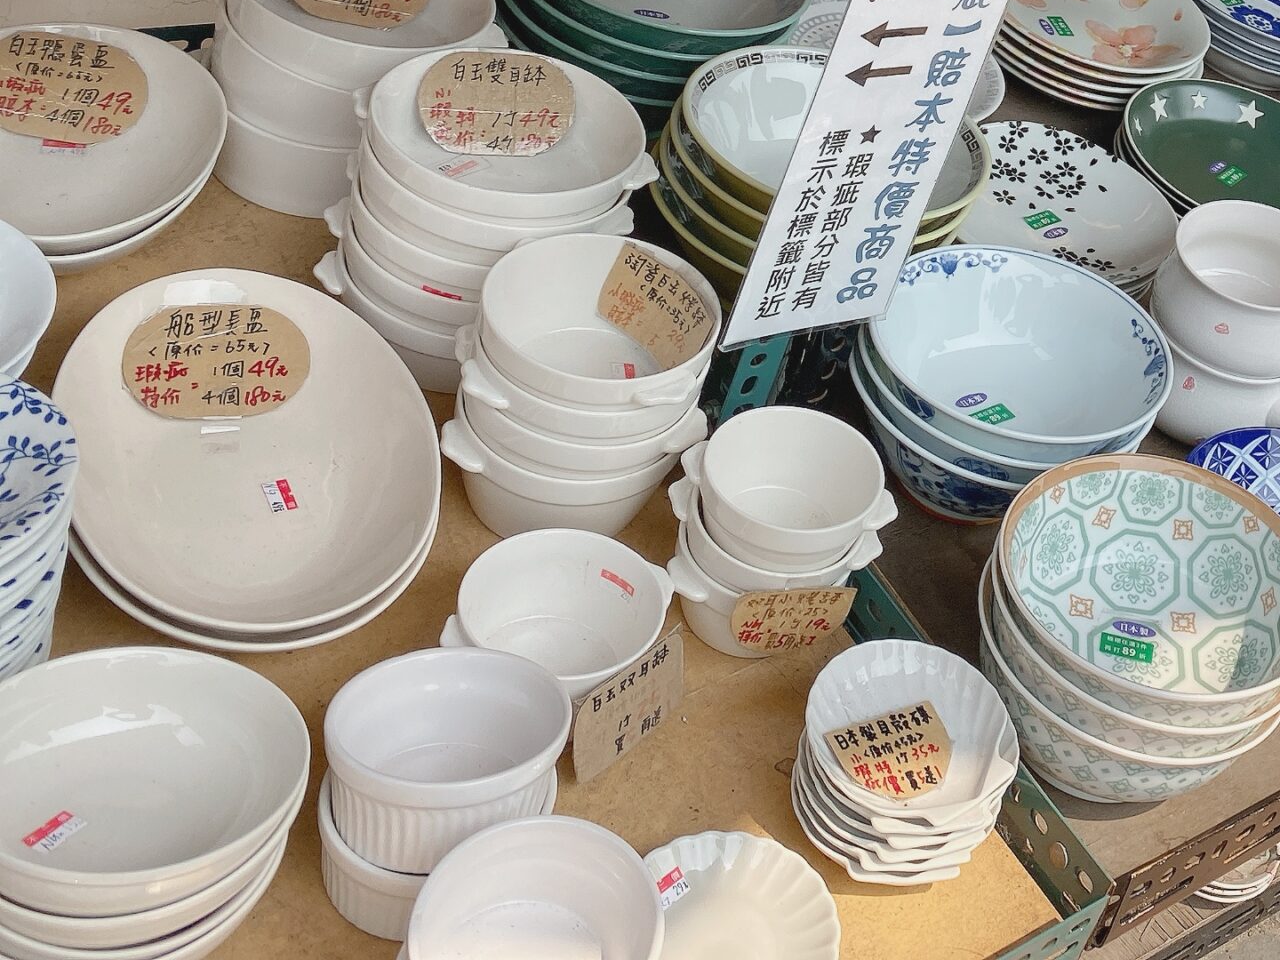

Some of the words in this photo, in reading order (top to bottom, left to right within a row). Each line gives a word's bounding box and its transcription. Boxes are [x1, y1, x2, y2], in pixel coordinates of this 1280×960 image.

[754, 129, 852, 321] 標示於標籤附近
[1120, 622, 1149, 636] 日本製
